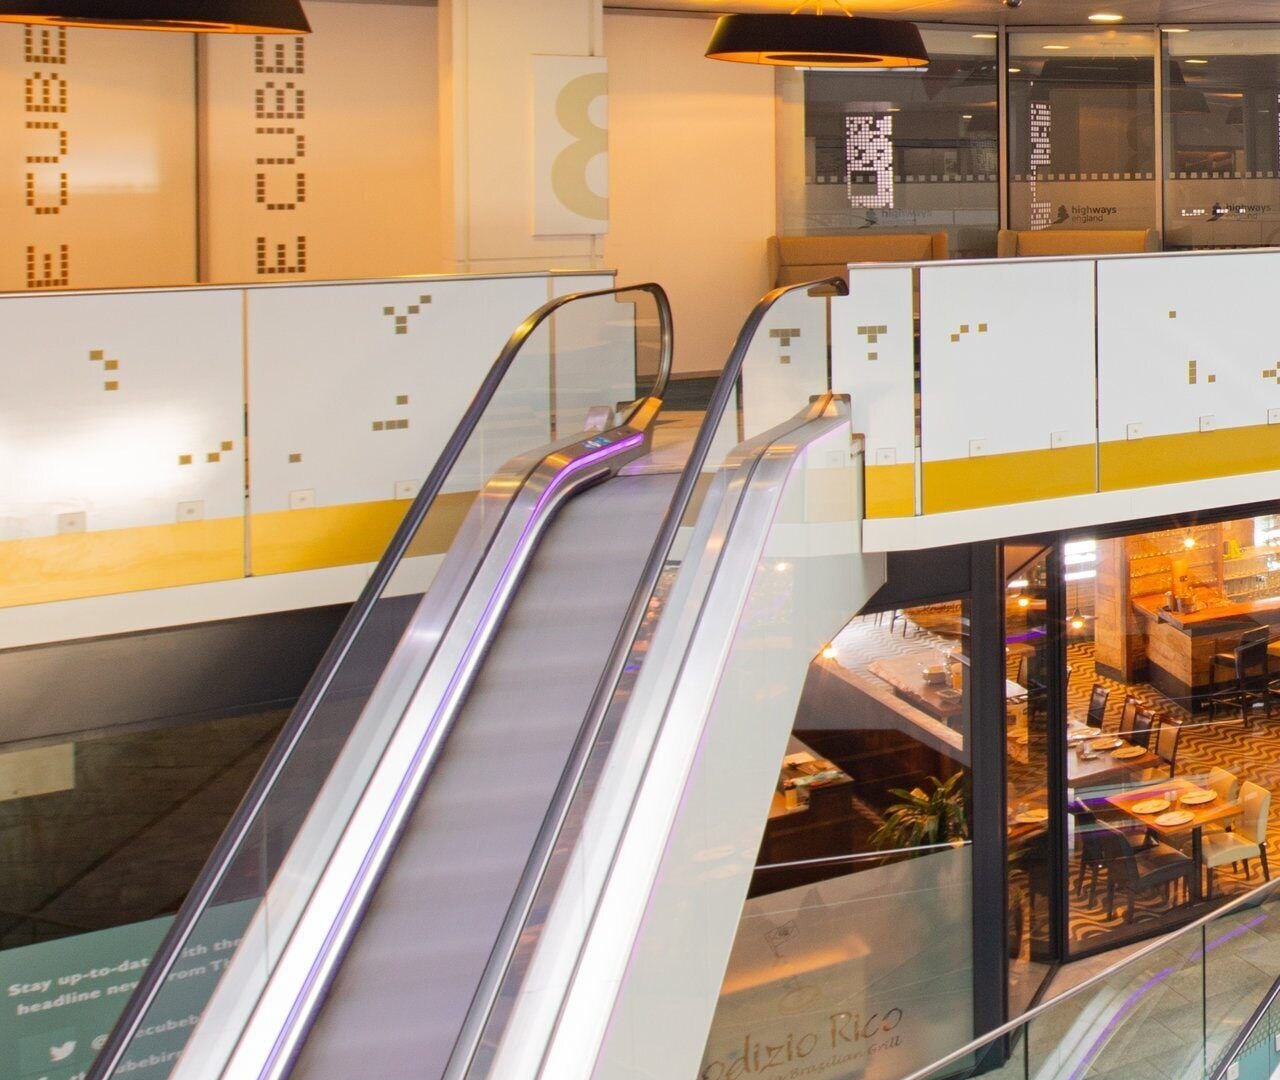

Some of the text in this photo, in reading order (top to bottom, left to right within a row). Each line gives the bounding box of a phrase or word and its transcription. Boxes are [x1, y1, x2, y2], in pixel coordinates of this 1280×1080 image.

[25, 23, 67, 215] CUBE
[255, 36, 305, 211] CUBE
[1071, 204, 1117, 215] highways
[8, 978, 51, 997] Stay
[58, 957, 150, 986] up-to-dat
[181, 944, 207, 958] ith
[17, 989, 101, 1016] headline
[167, 967, 206, 981] rom
[829, 1007, 903, 1048] Rico
